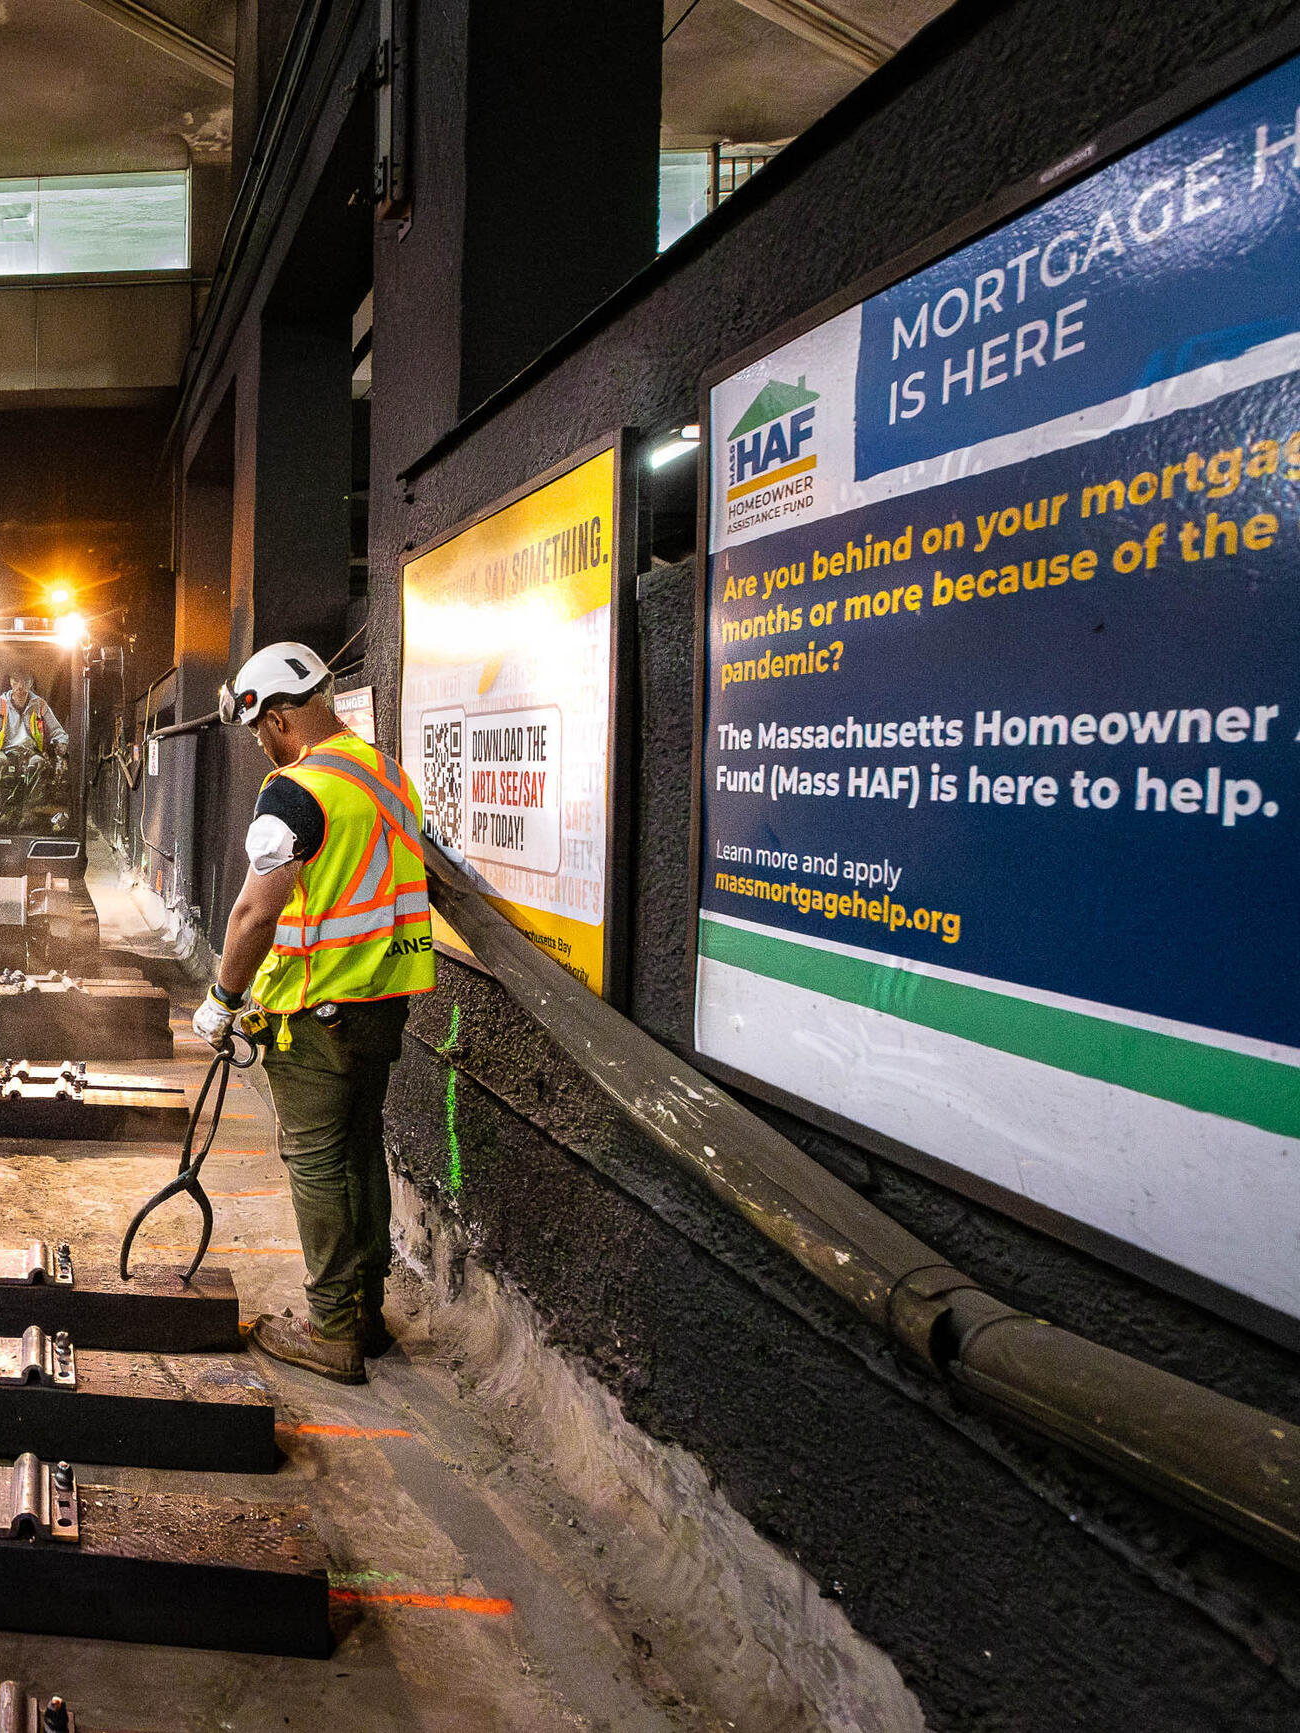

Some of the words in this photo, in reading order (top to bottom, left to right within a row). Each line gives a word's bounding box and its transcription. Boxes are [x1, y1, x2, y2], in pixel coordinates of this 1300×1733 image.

[891, 147, 1225, 361] MORTGAGE
[888, 370, 926, 426] IS
[942, 298, 1088, 405] HERE
[736, 405, 816, 482] HAF
[727, 507, 781, 535] ASSISTANCE
[783, 496, 814, 515] FUND
[728, 476, 814, 520] HOMEOWNER
[512, 515, 608, 596] SOMETHING.
[723, 575, 758, 602] Are
[763, 561, 805, 600] you
[812, 525, 914, 582] behind
[922, 520, 965, 555] on
[974, 493, 1069, 552] your
[721, 603, 803, 645] months
[809, 600, 837, 628] or
[844, 583, 923, 622] more
[931, 549, 1099, 607] because
[1113, 521, 1168, 575] of
[1178, 512, 1280, 563] the
[721, 640, 844, 692] pandemic?
[472, 727, 524, 763] DOWNLOAD
[527, 725, 547, 762] THE
[717, 722, 752, 750] The
[757, 714, 964, 750] Massachusetts
[973, 704, 1279, 747] Homeowner
[472, 770, 498, 804] MBTA
[500, 770, 546, 809] SEE/SAY
[716, 764, 765, 794] Fund
[770, 764, 840, 801] (Mass
[847, 765, 920, 809] HAF)
[930, 763, 958, 802] is
[968, 765, 1060, 807] here
[1070, 770, 1121, 810] to
[1134, 766, 1280, 827] help.
[472, 811, 489, 845] APP
[490, 814, 525, 852] TODAY!
[716, 839, 752, 865] Learn
[756, 849, 798, 871] more
[802, 852, 838, 877] and
[843, 858, 903, 892] apply
[715, 872, 961, 944] massmortgagehelp.org
[558, 936, 572, 957] Bay
